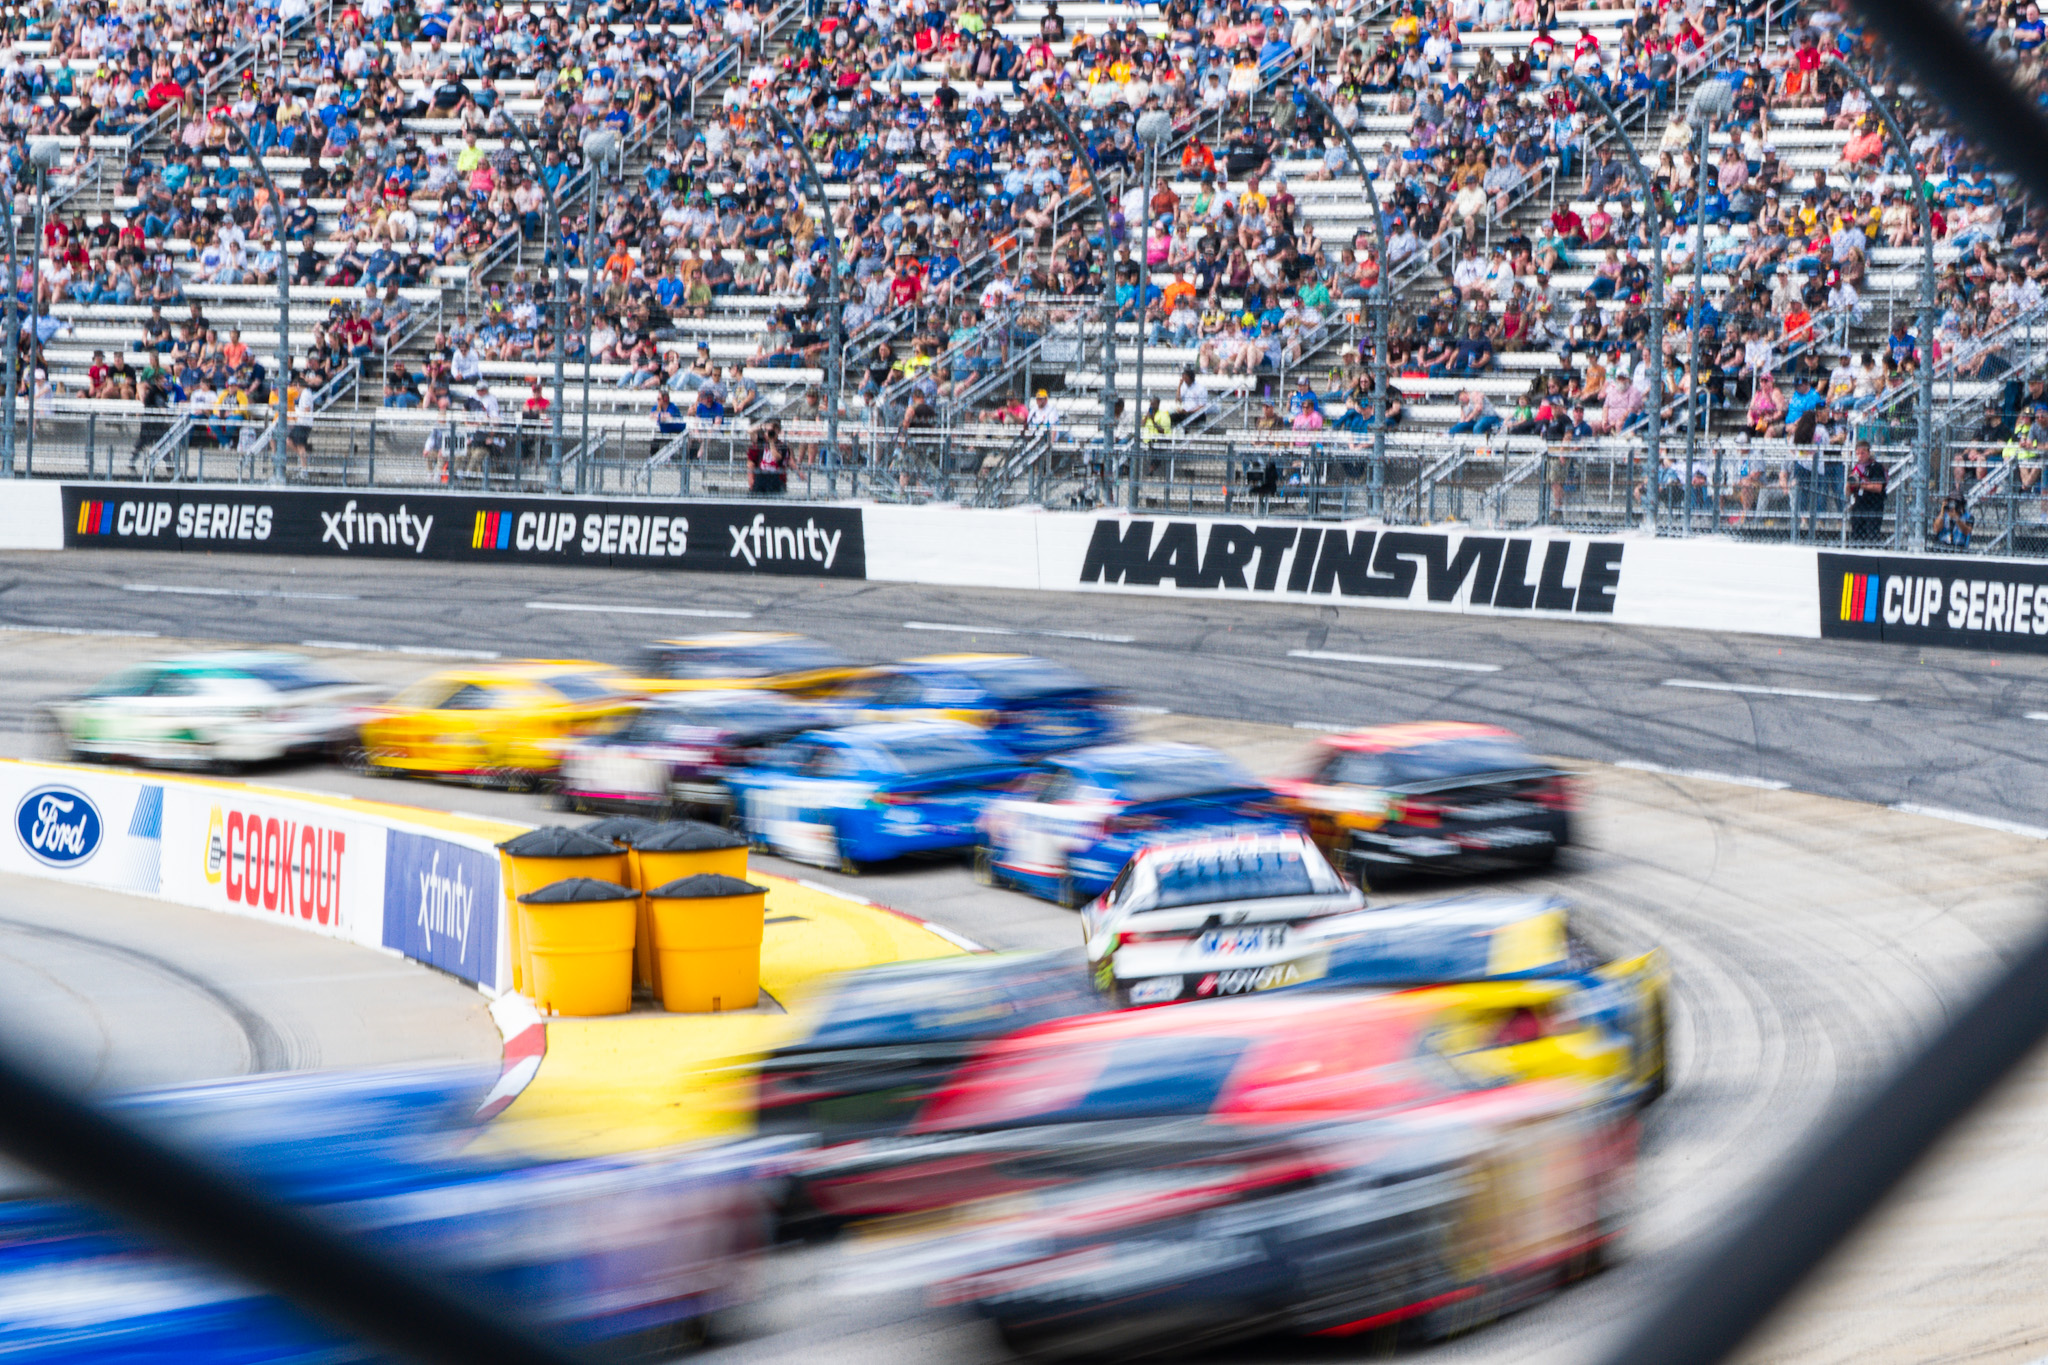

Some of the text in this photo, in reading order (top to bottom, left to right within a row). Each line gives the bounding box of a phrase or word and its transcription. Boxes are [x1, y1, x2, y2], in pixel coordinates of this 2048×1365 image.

[117, 501, 273, 540] CUP SERIES
[321, 500, 434, 553] xfinity
[516, 511, 689, 557] CUP SERIES
[729, 513, 842, 569] xfinity
[1079, 519, 1625, 614] MARTINSVILLE
[1883, 575, 2048, 635] CUP SERIES
[31, 794, 87, 855] Ford
[226, 810, 346, 926] COOK OUT
[418, 849, 472, 965] xfinity
[1217, 963, 1301, 996] TOYOTA
